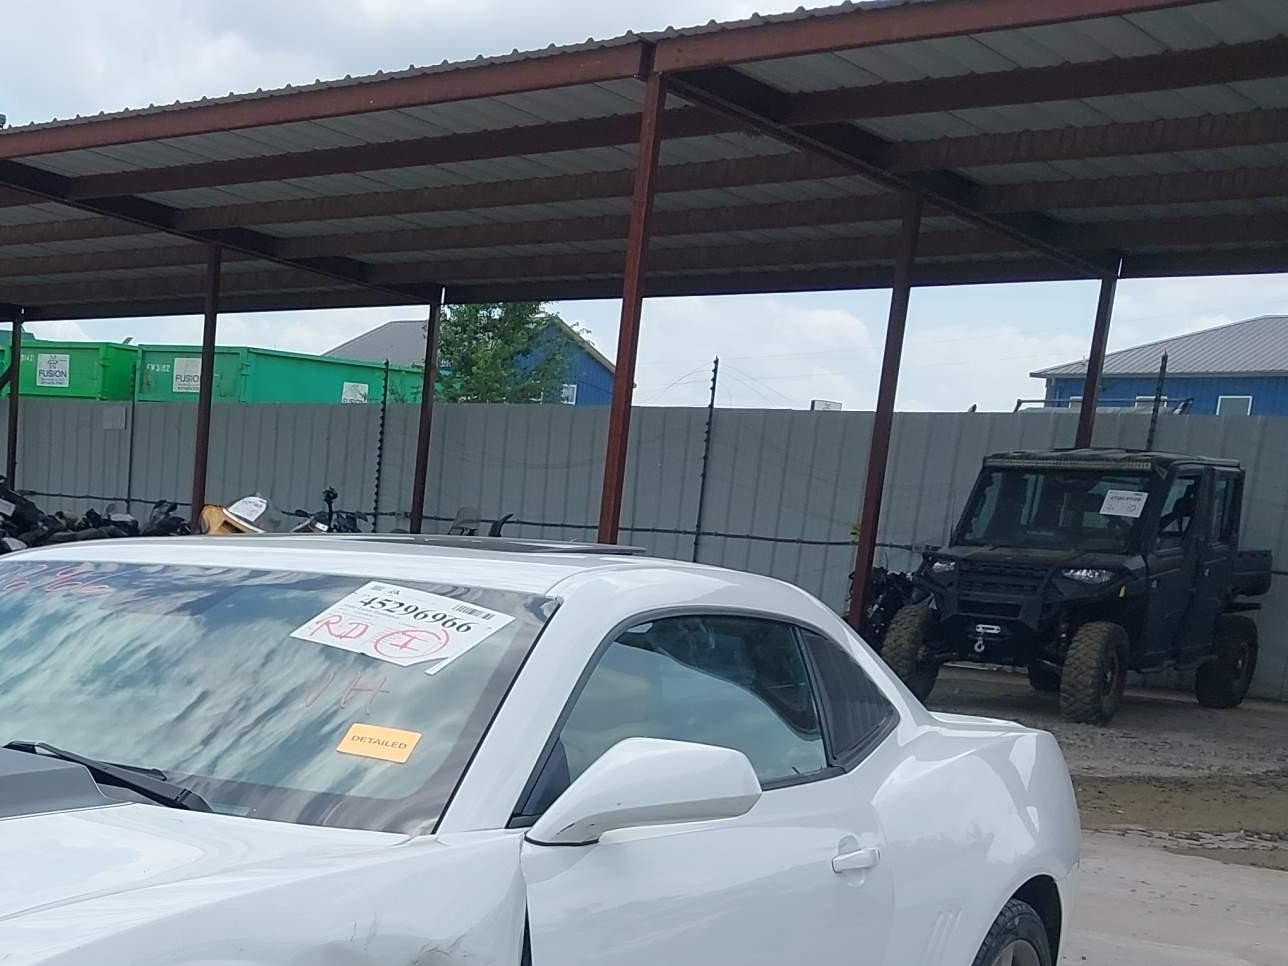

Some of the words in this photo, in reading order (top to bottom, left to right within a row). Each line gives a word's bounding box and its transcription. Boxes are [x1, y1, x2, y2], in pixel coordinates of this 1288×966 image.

[39, 369, 67, 378] FUSION
[176, 374, 199, 383] FUSIO
[360, 597, 478, 633] 45296966
[351, 735, 408, 750] DETAILED
